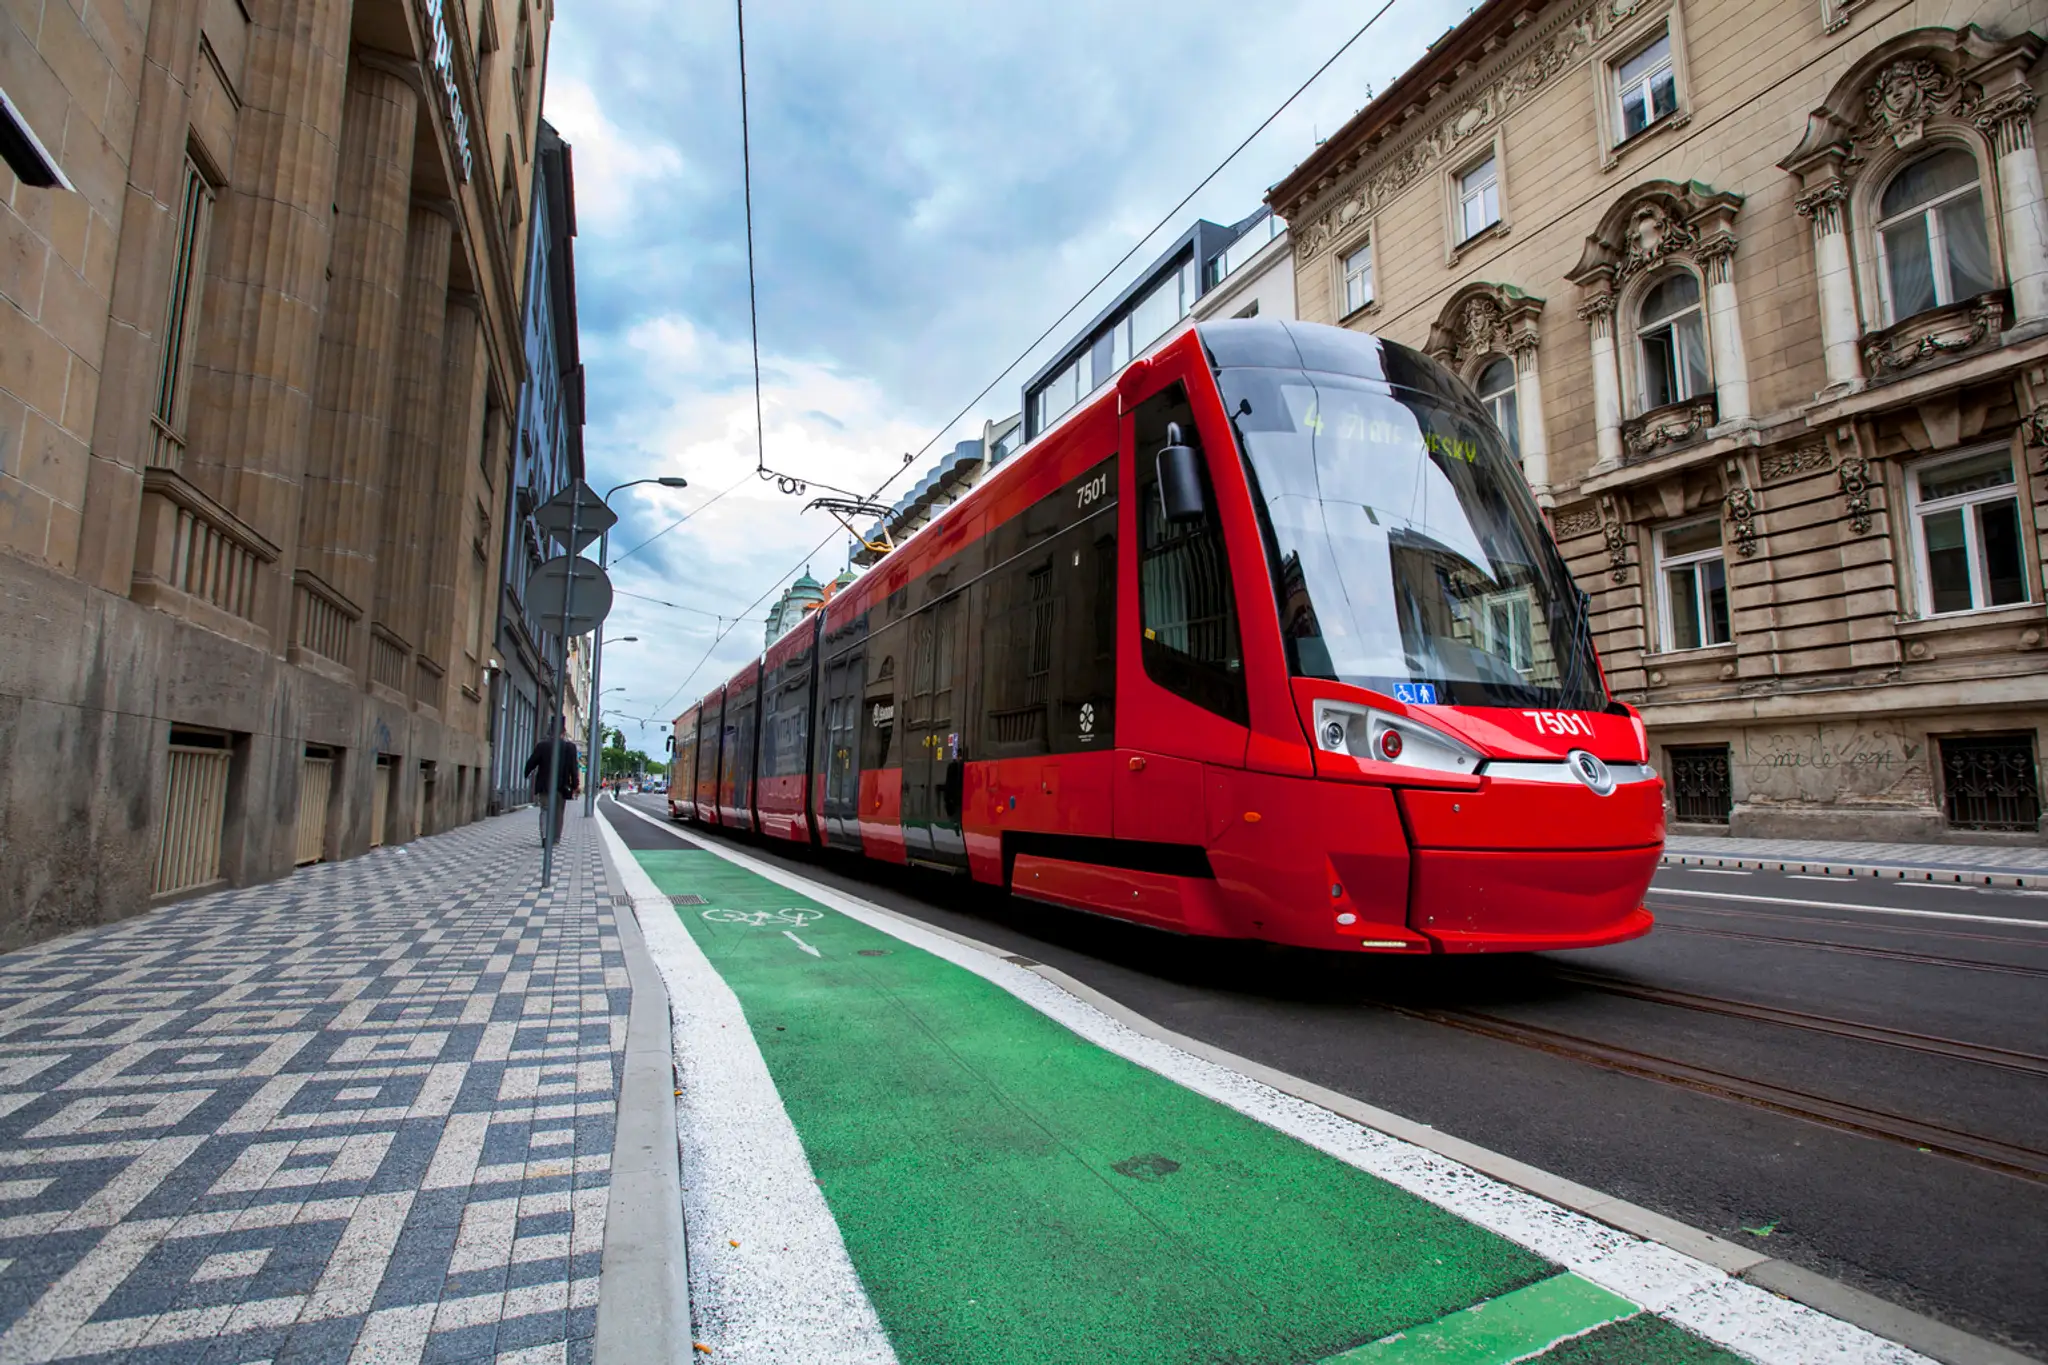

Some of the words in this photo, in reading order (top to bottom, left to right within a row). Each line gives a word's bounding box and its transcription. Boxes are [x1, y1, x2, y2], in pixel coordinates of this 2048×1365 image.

[1303, 400, 1325, 436] 4
[1076, 473, 1107, 509] 7501
[1522, 711, 1592, 736] 7501
